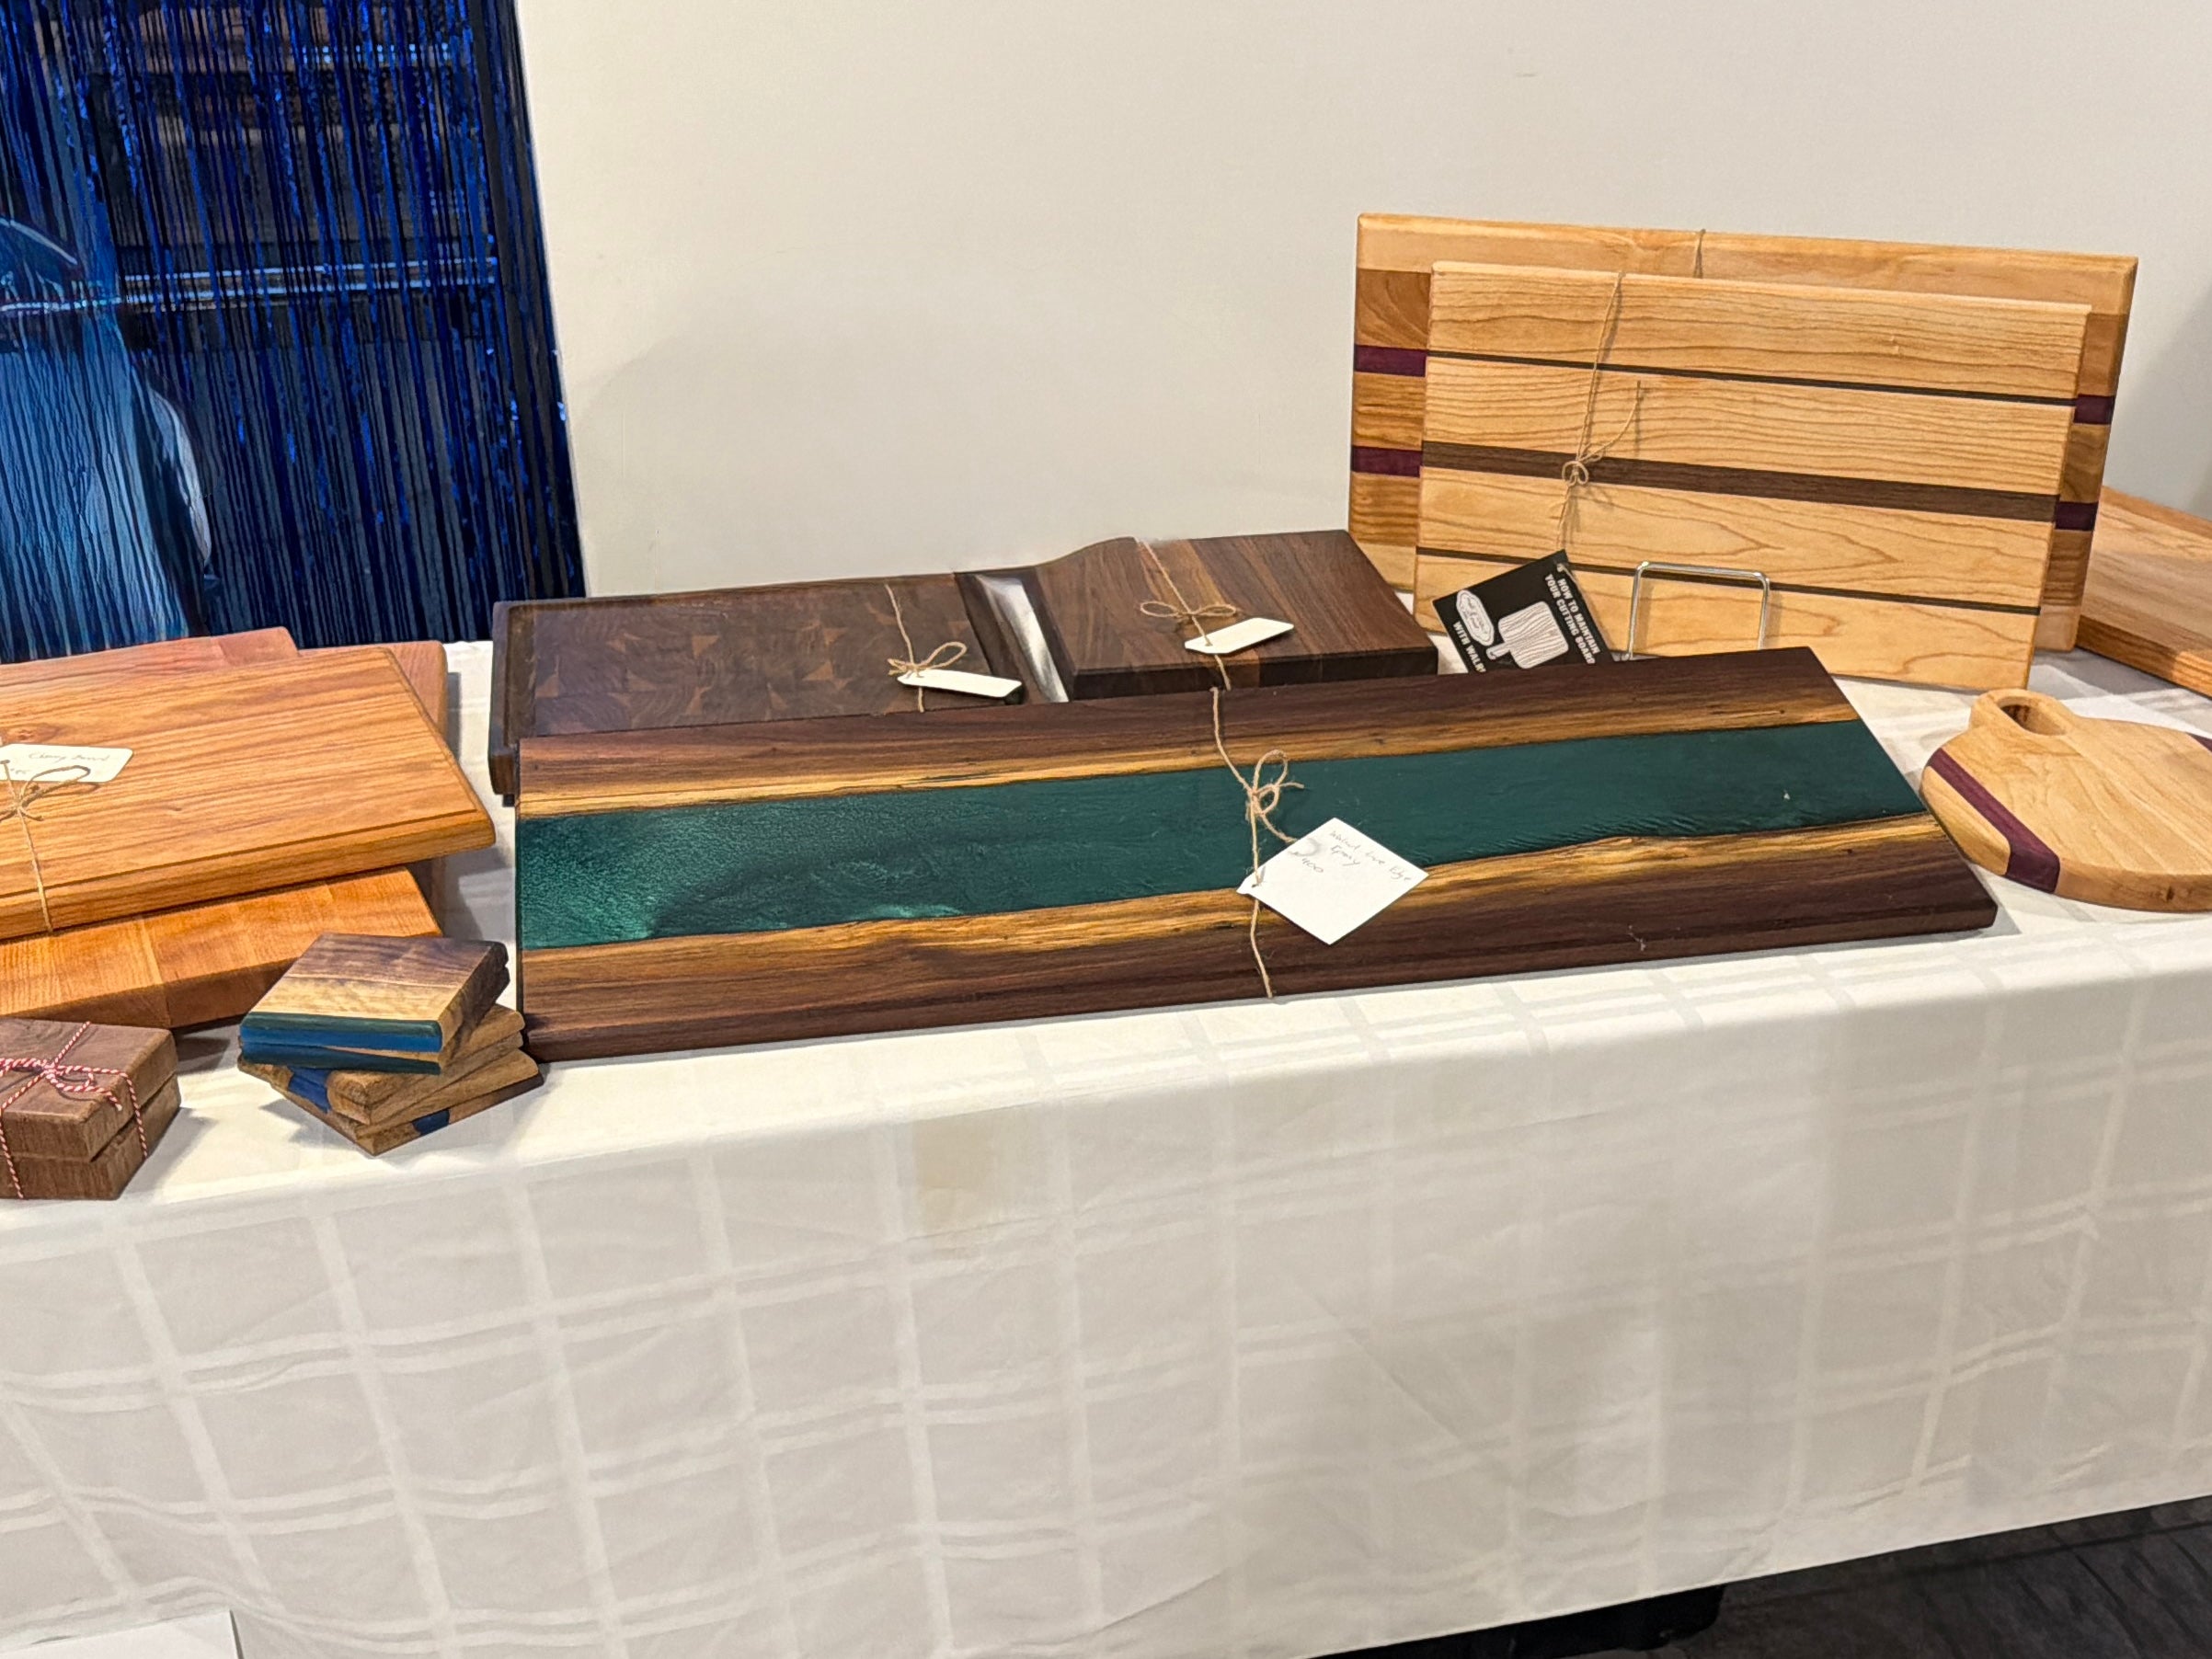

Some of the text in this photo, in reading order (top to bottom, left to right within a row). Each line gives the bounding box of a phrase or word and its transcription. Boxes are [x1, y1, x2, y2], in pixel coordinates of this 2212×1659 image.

[1452, 621, 1472, 646] WITH
[1543, 573, 1562, 598] YOUR
[1555, 599, 1580, 636] CUTTING
[1556, 578, 1600, 655] HOW TO MAINTAIN
